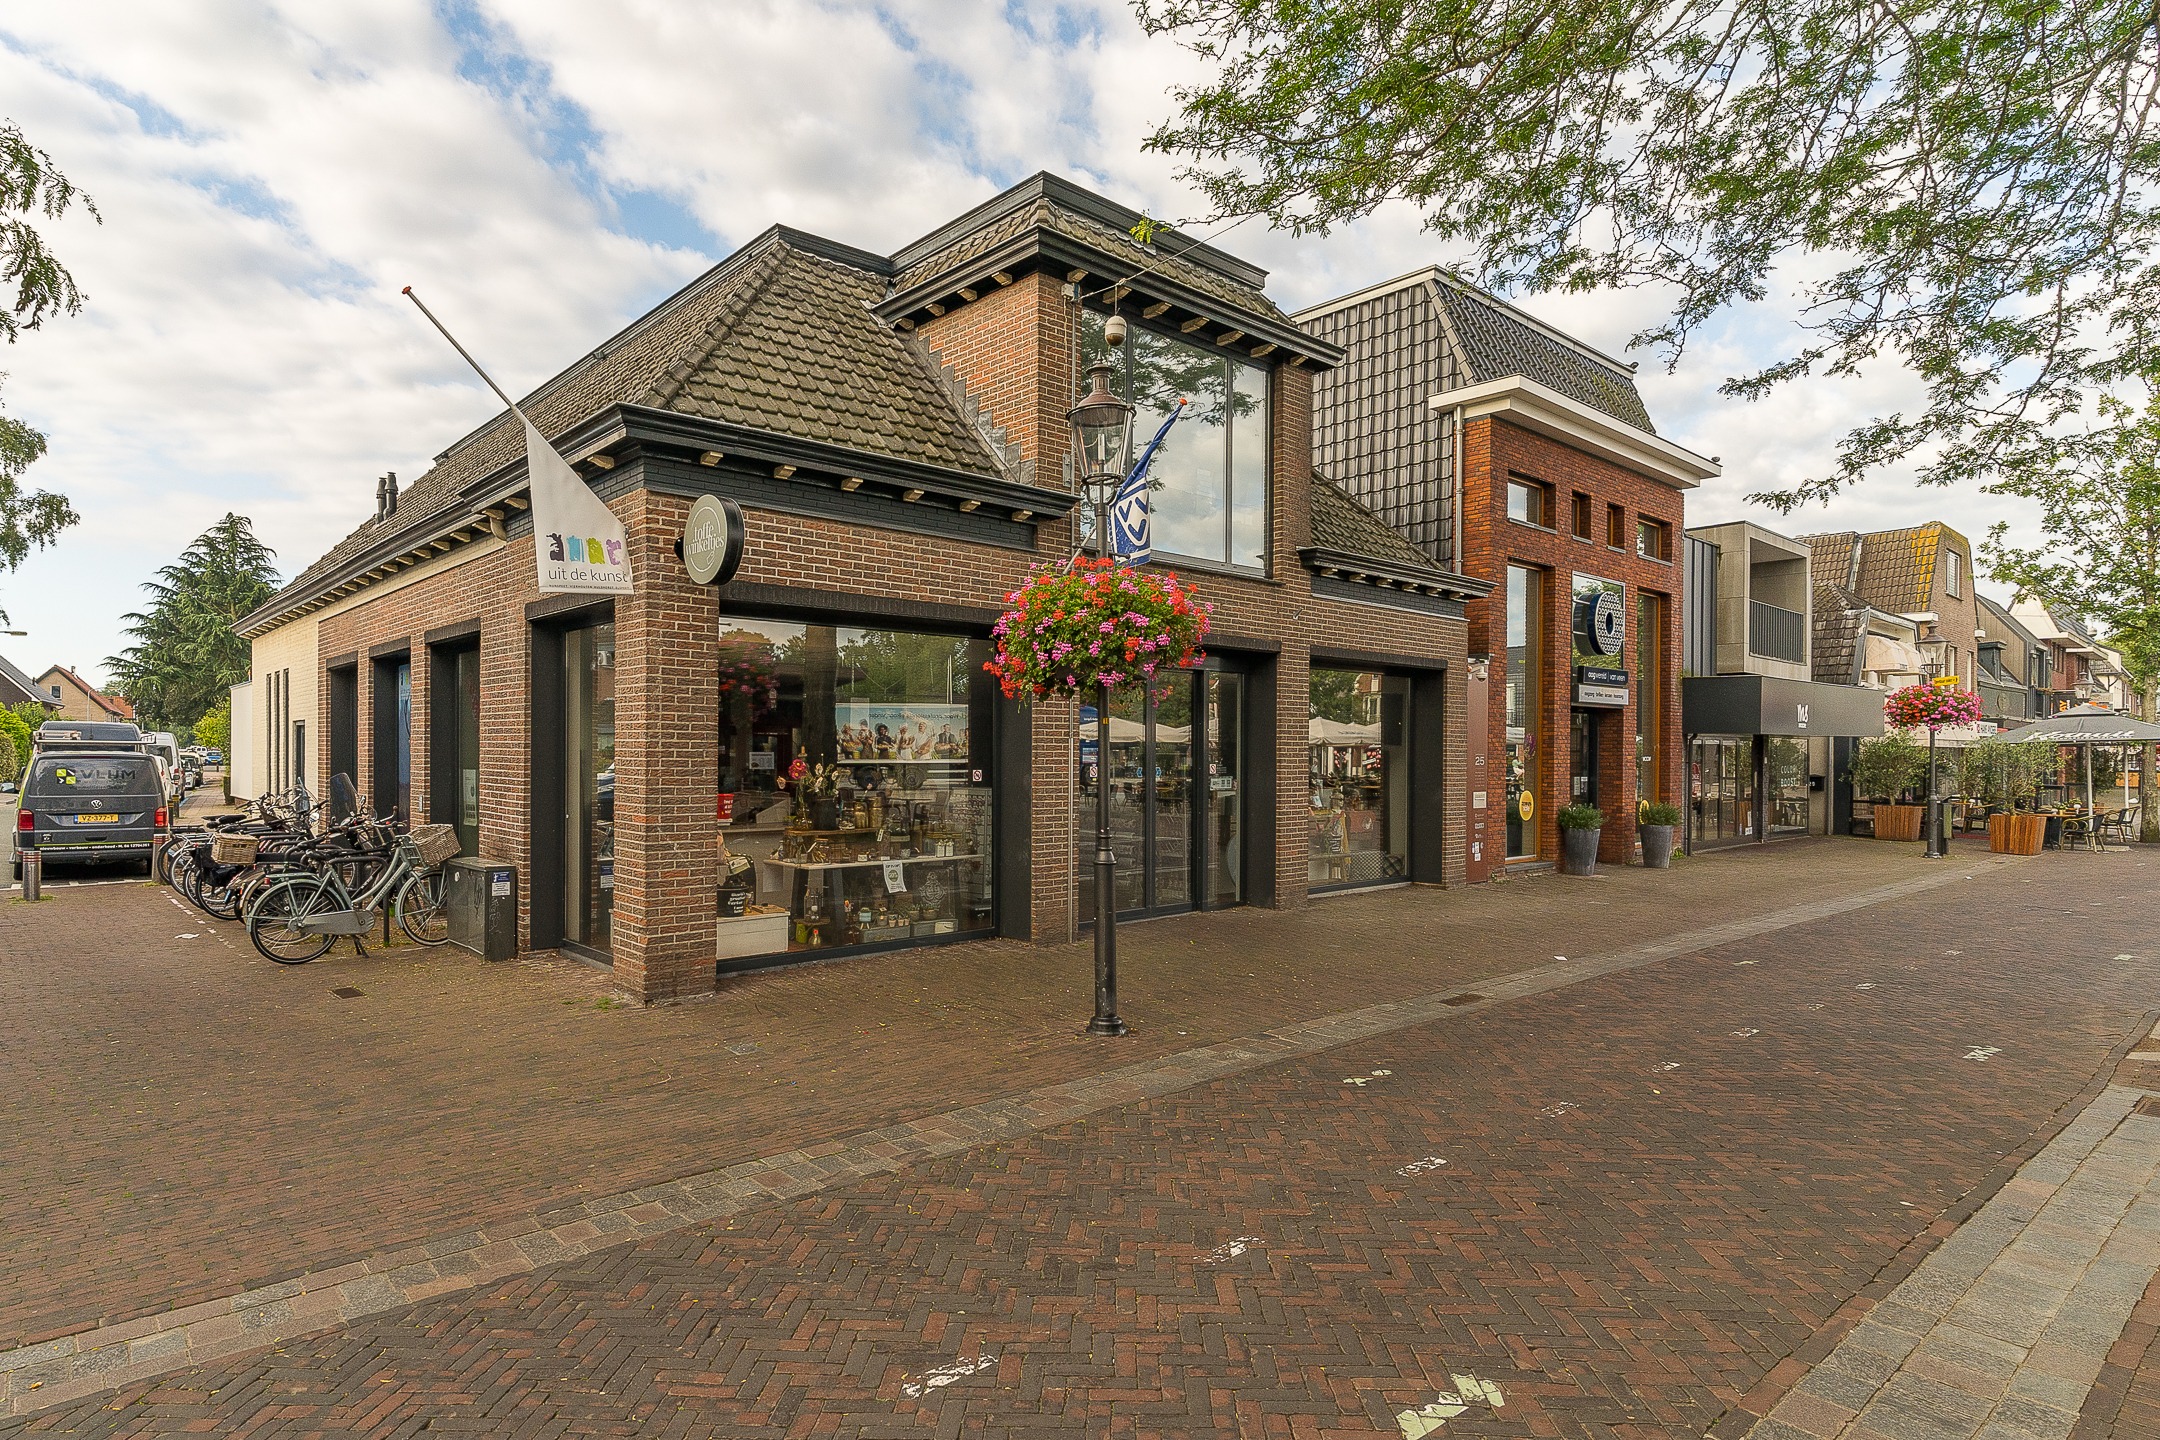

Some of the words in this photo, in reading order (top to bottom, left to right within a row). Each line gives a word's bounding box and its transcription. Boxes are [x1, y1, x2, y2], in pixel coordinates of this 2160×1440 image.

[694, 521, 714, 541] toffe
[685, 534, 725, 556] winkeltjes
[548, 567, 568, 580] uit
[570, 568, 587, 581] de
[590, 569, 628, 583] kunst
[1474, 756, 1485, 766] 25
